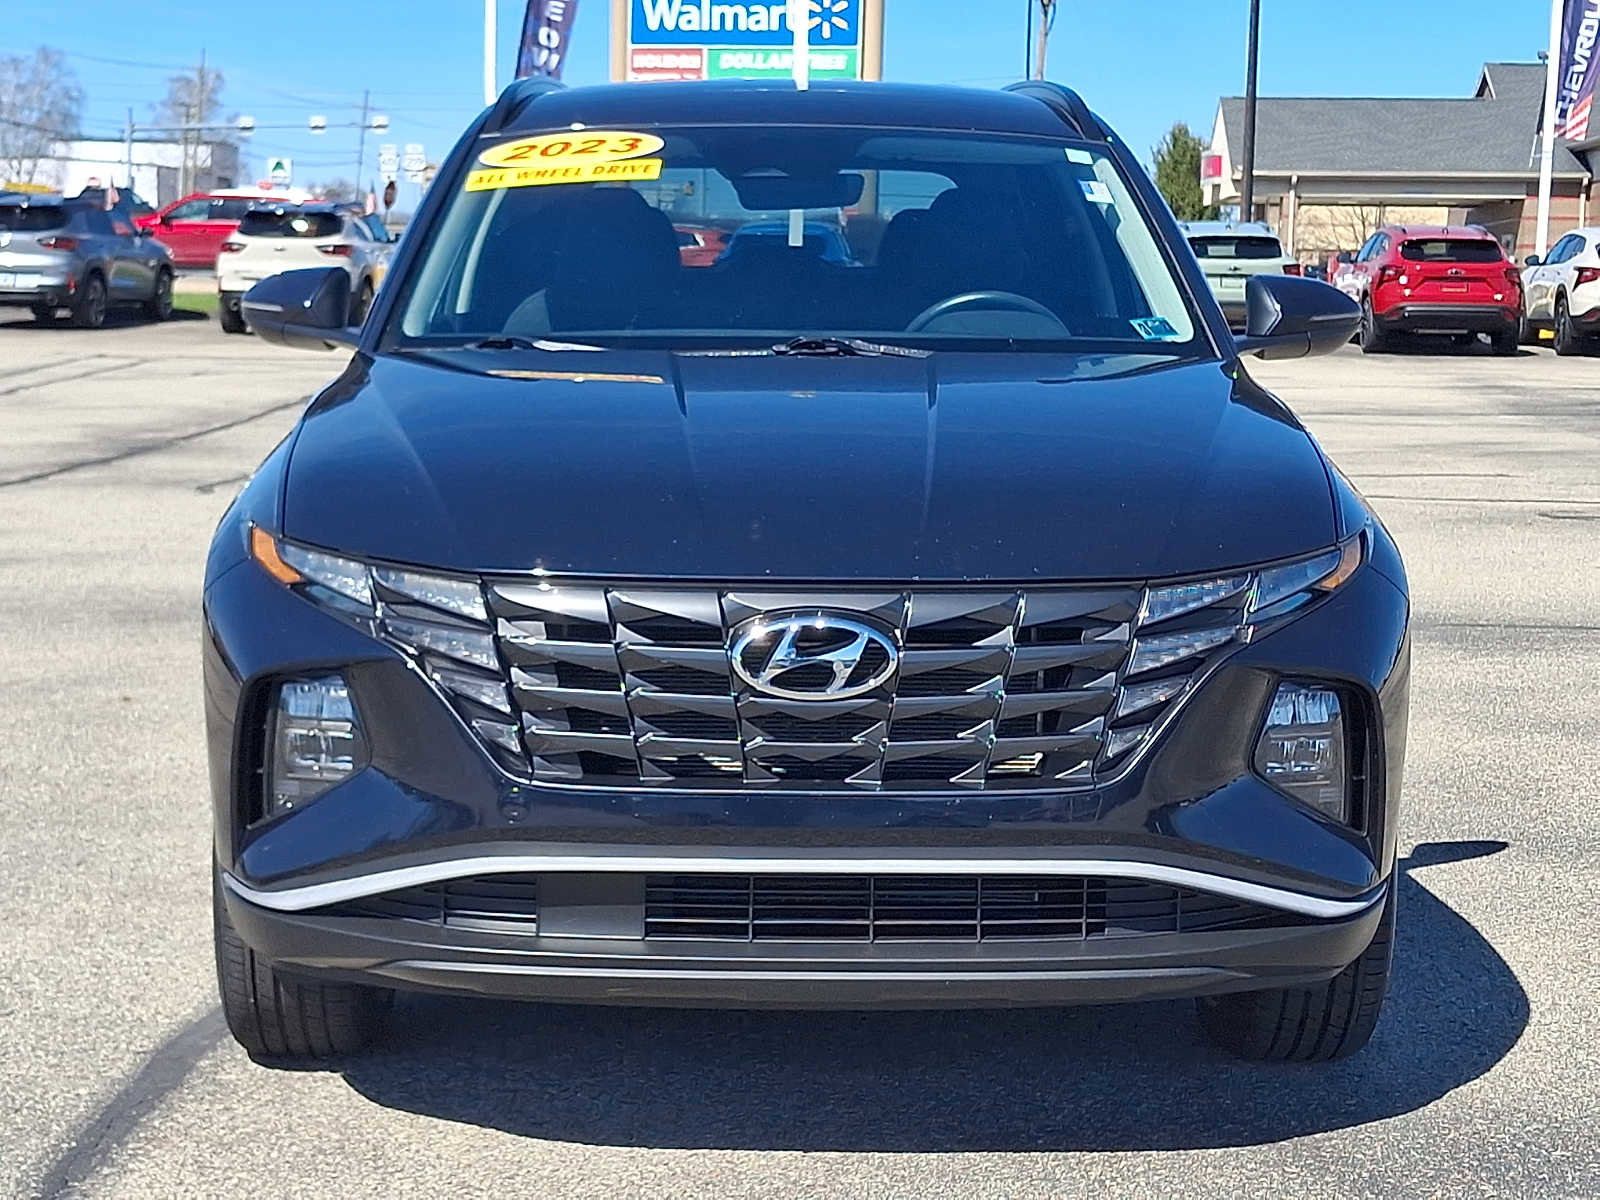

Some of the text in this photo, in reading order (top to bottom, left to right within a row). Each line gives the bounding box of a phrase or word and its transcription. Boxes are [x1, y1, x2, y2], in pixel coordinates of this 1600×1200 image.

[642, 0, 799, 32] Walmart
[1554, 0, 1600, 126] CHEVROL
[502, 137, 644, 162] 2023
[474, 163, 653, 185] ALL WHEEL DRIVE
